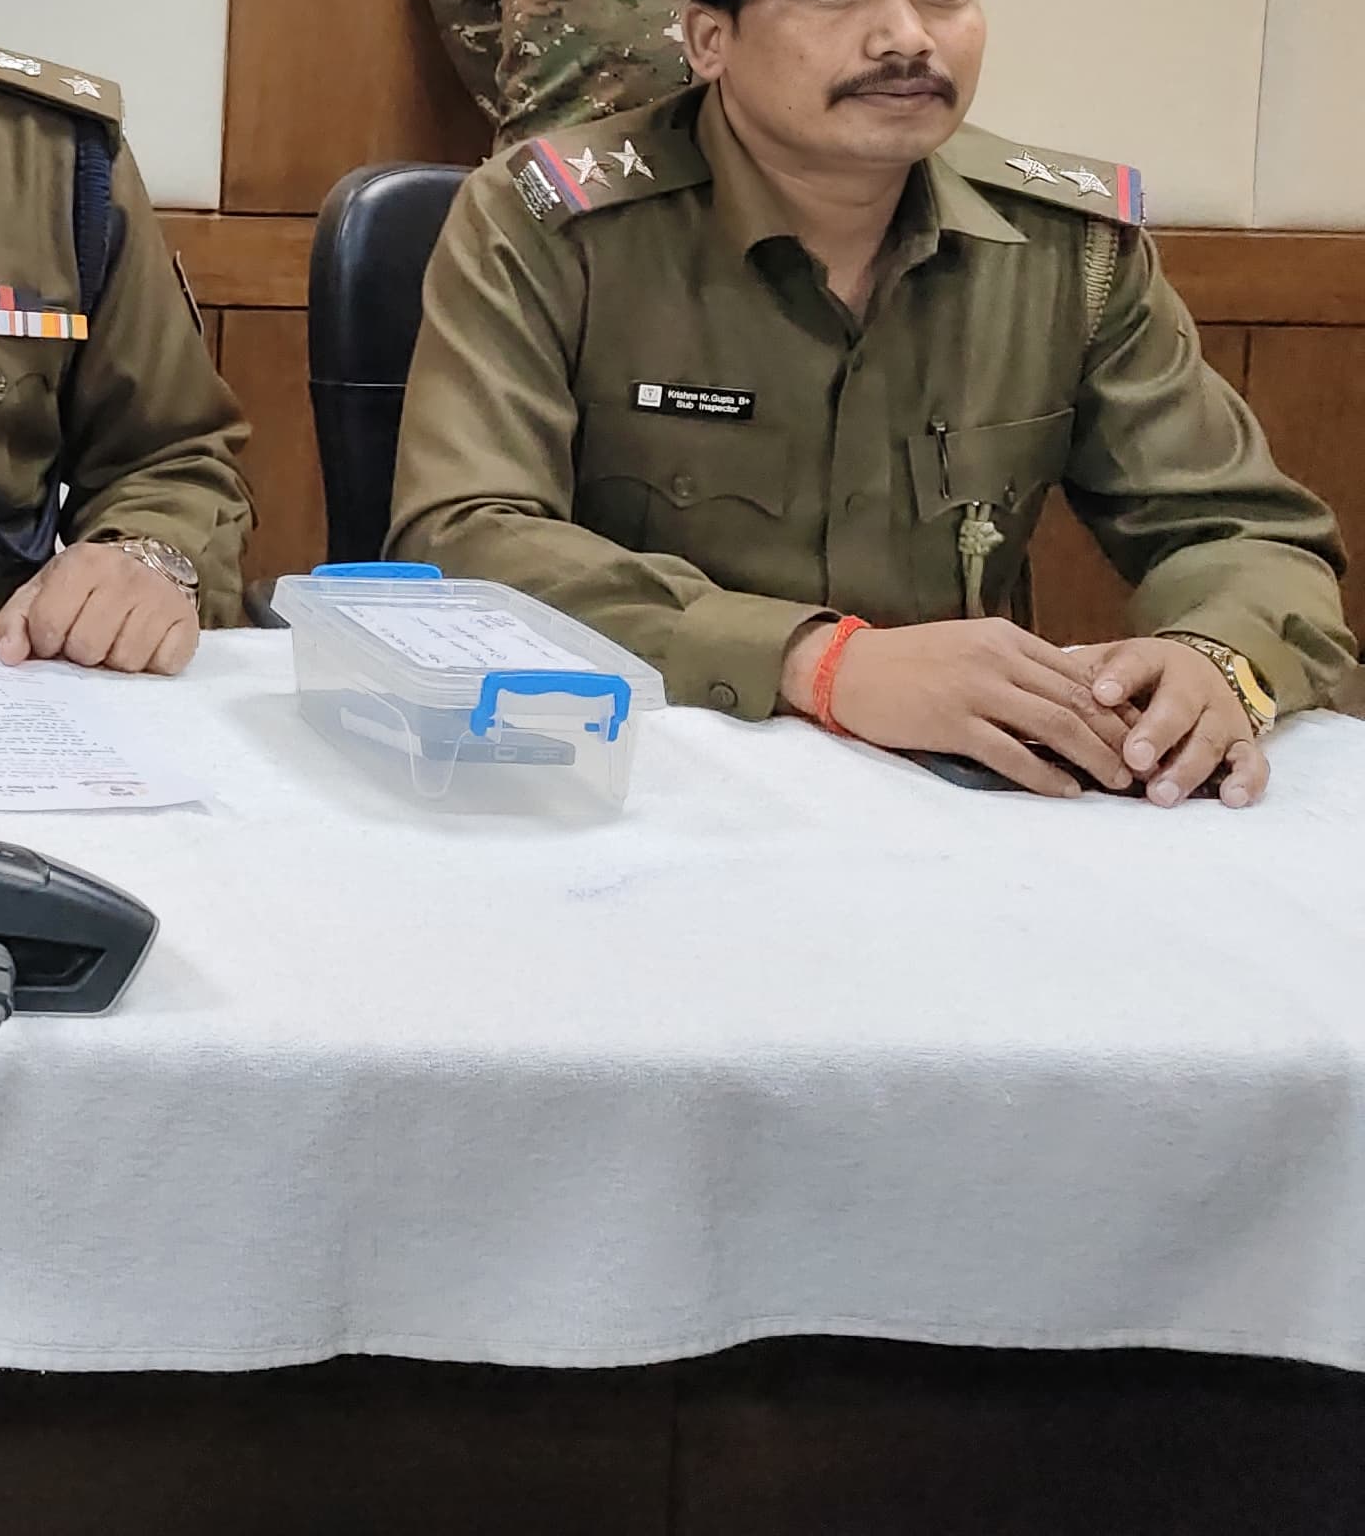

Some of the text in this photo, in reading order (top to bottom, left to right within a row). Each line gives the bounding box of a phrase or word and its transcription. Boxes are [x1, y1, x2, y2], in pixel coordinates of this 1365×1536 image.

[667, 389, 699, 401] Krishna
[675, 399, 741, 414] Sub Inspector
